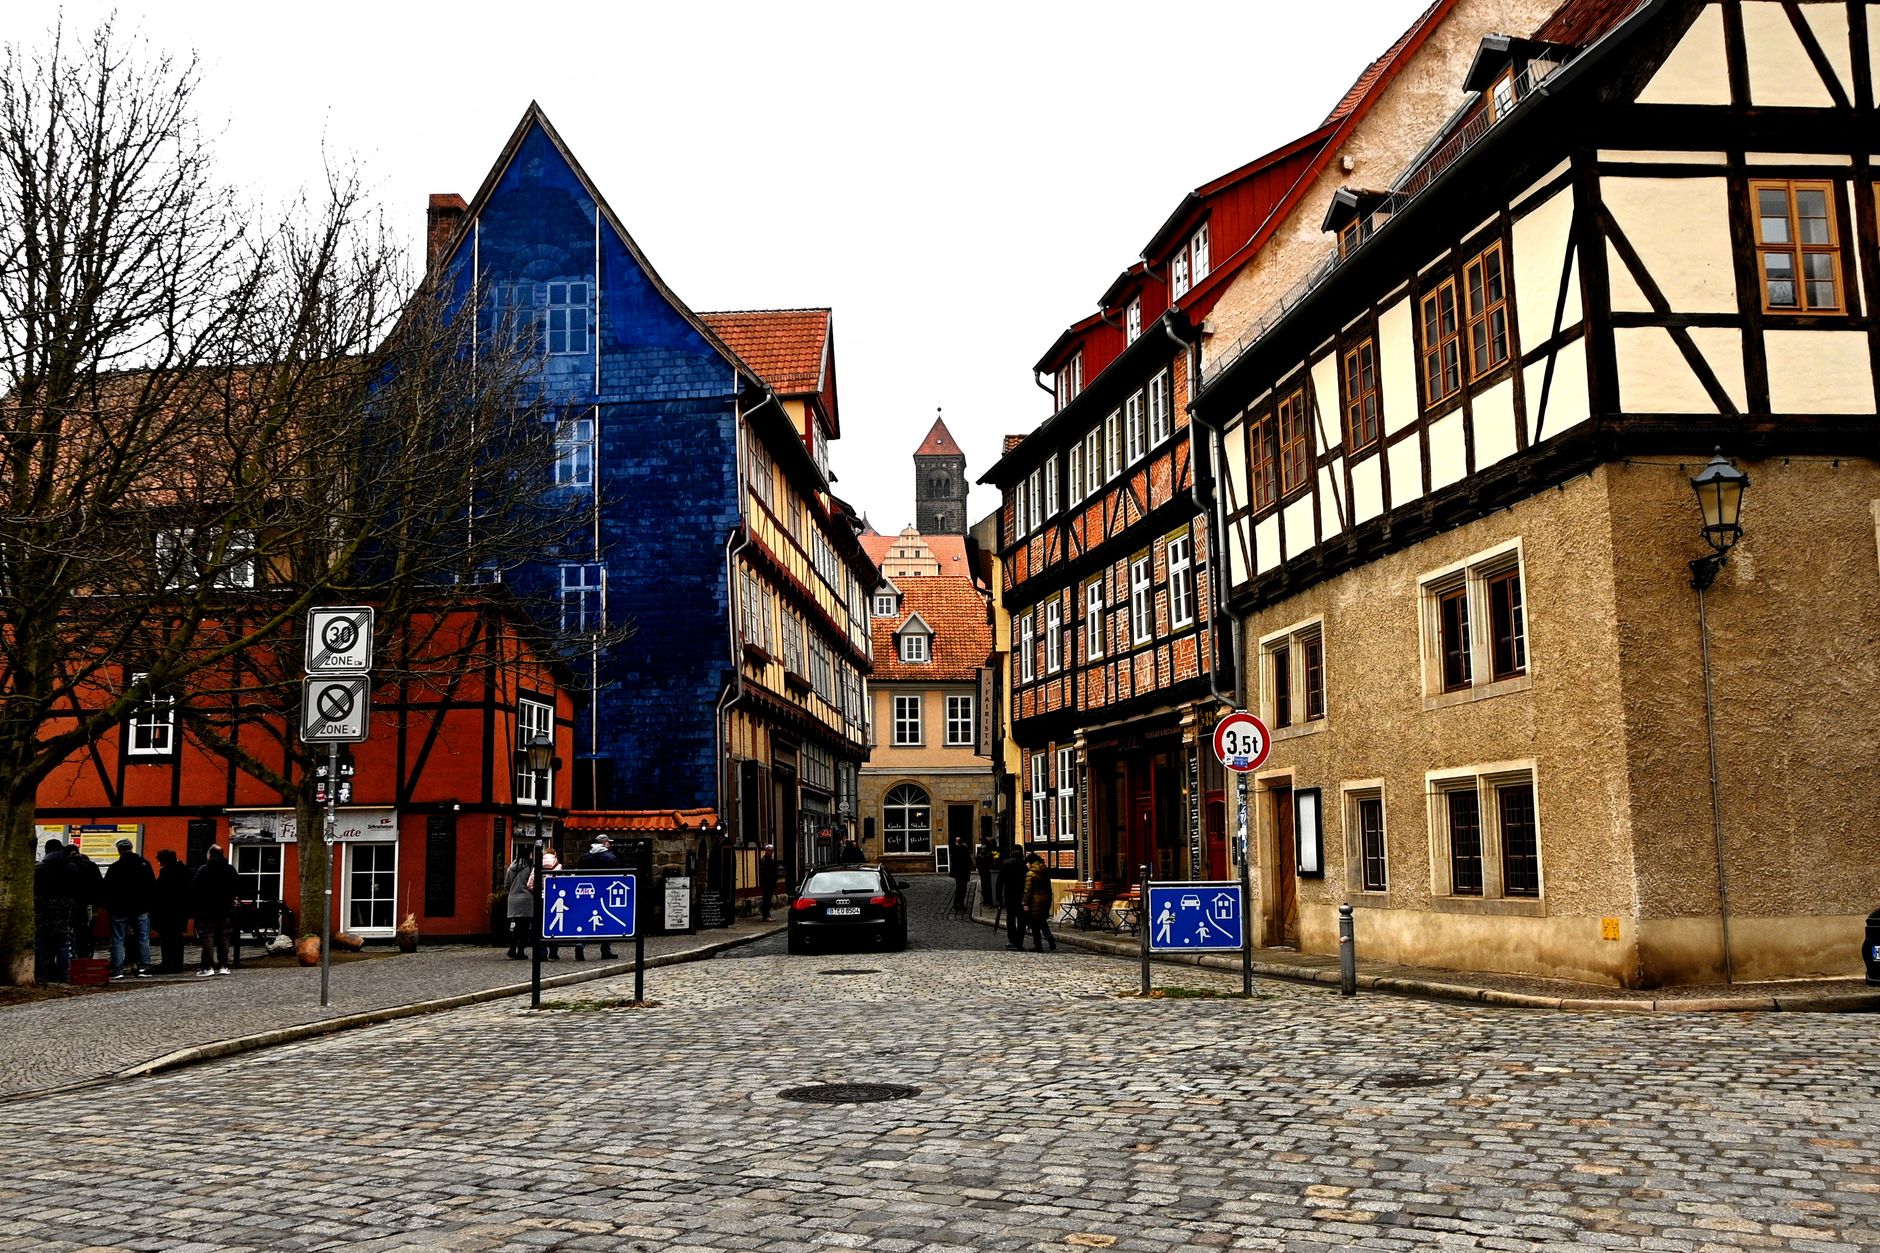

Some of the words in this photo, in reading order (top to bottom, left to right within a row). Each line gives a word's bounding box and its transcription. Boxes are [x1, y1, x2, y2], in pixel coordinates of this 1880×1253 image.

[329, 626, 351, 644] 30
[324, 655, 353, 666] ZONE
[319, 724, 349, 735] ZONE
[1226, 730, 1259, 756] 3,5t
